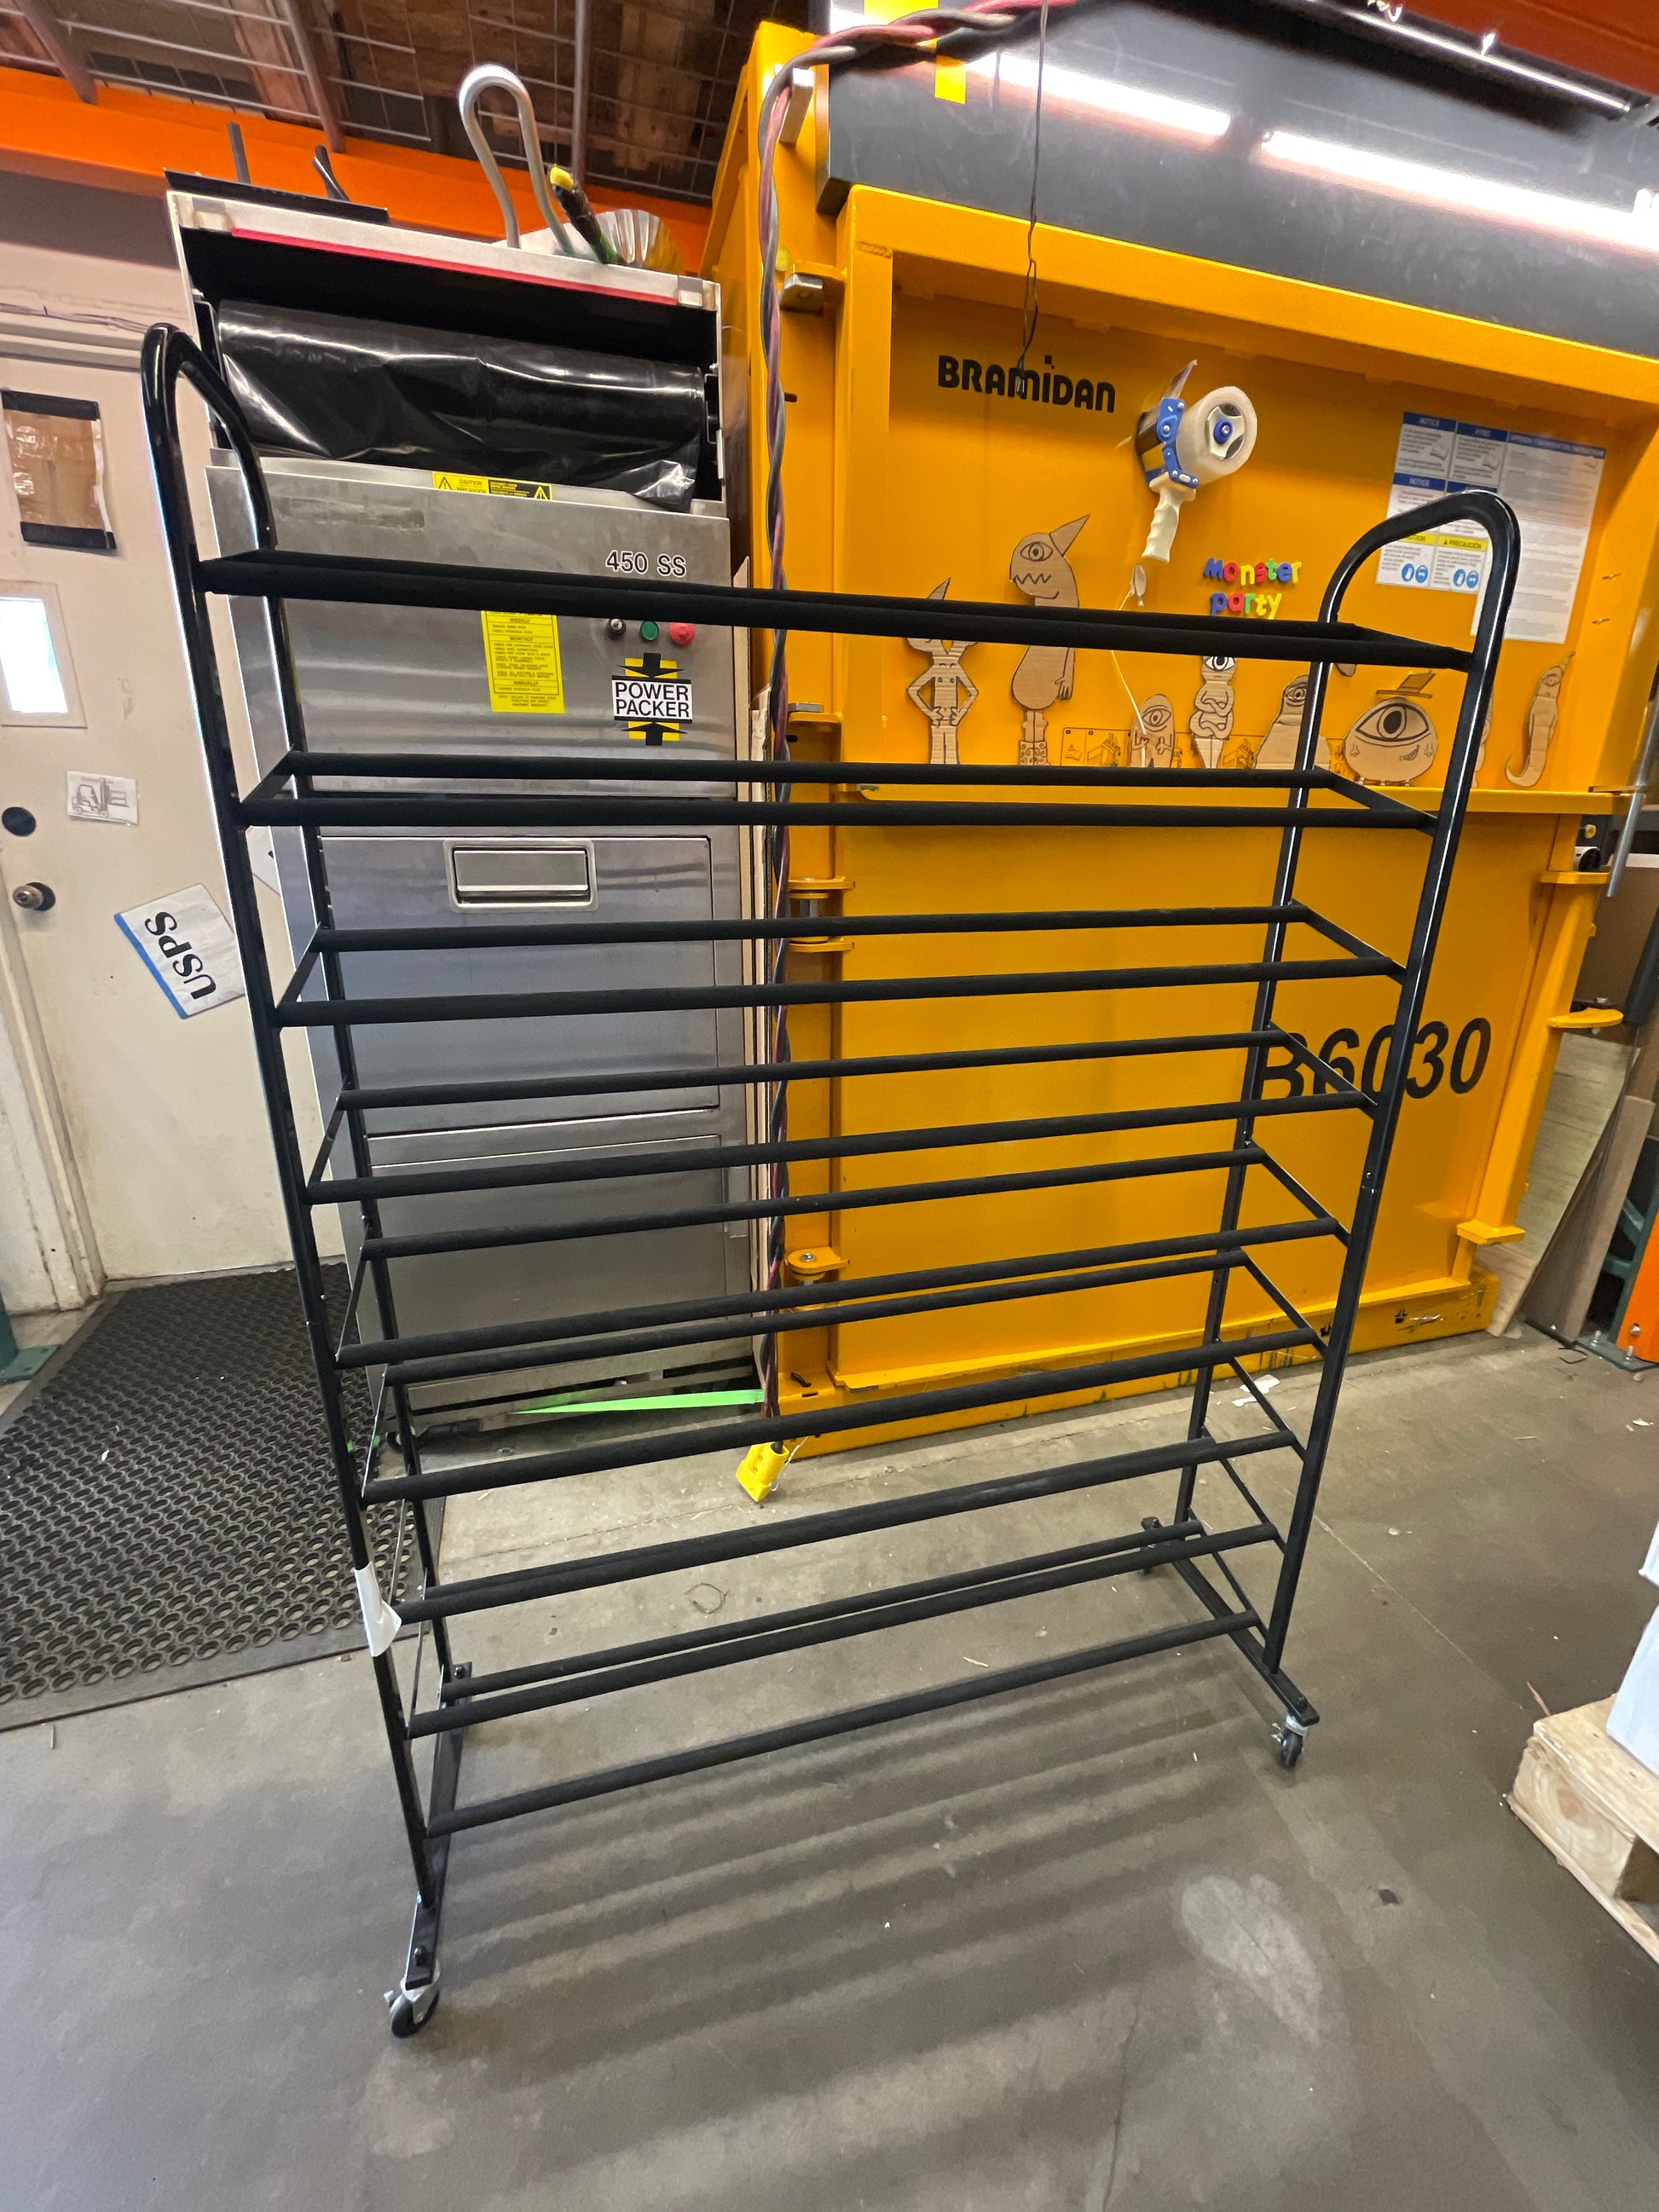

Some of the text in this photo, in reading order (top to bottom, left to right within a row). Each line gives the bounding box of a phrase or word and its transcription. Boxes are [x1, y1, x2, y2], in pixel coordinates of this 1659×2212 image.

[1408, 477, 1431, 487] NOTICE
[605, 550, 686, 577] 450 SS
[1203, 557, 1302, 586] Monster
[1210, 592, 1282, 620] party
[615, 681, 689, 701] POWER
[616, 699, 690, 718] PACKER
[144, 911, 217, 1000] USPS
